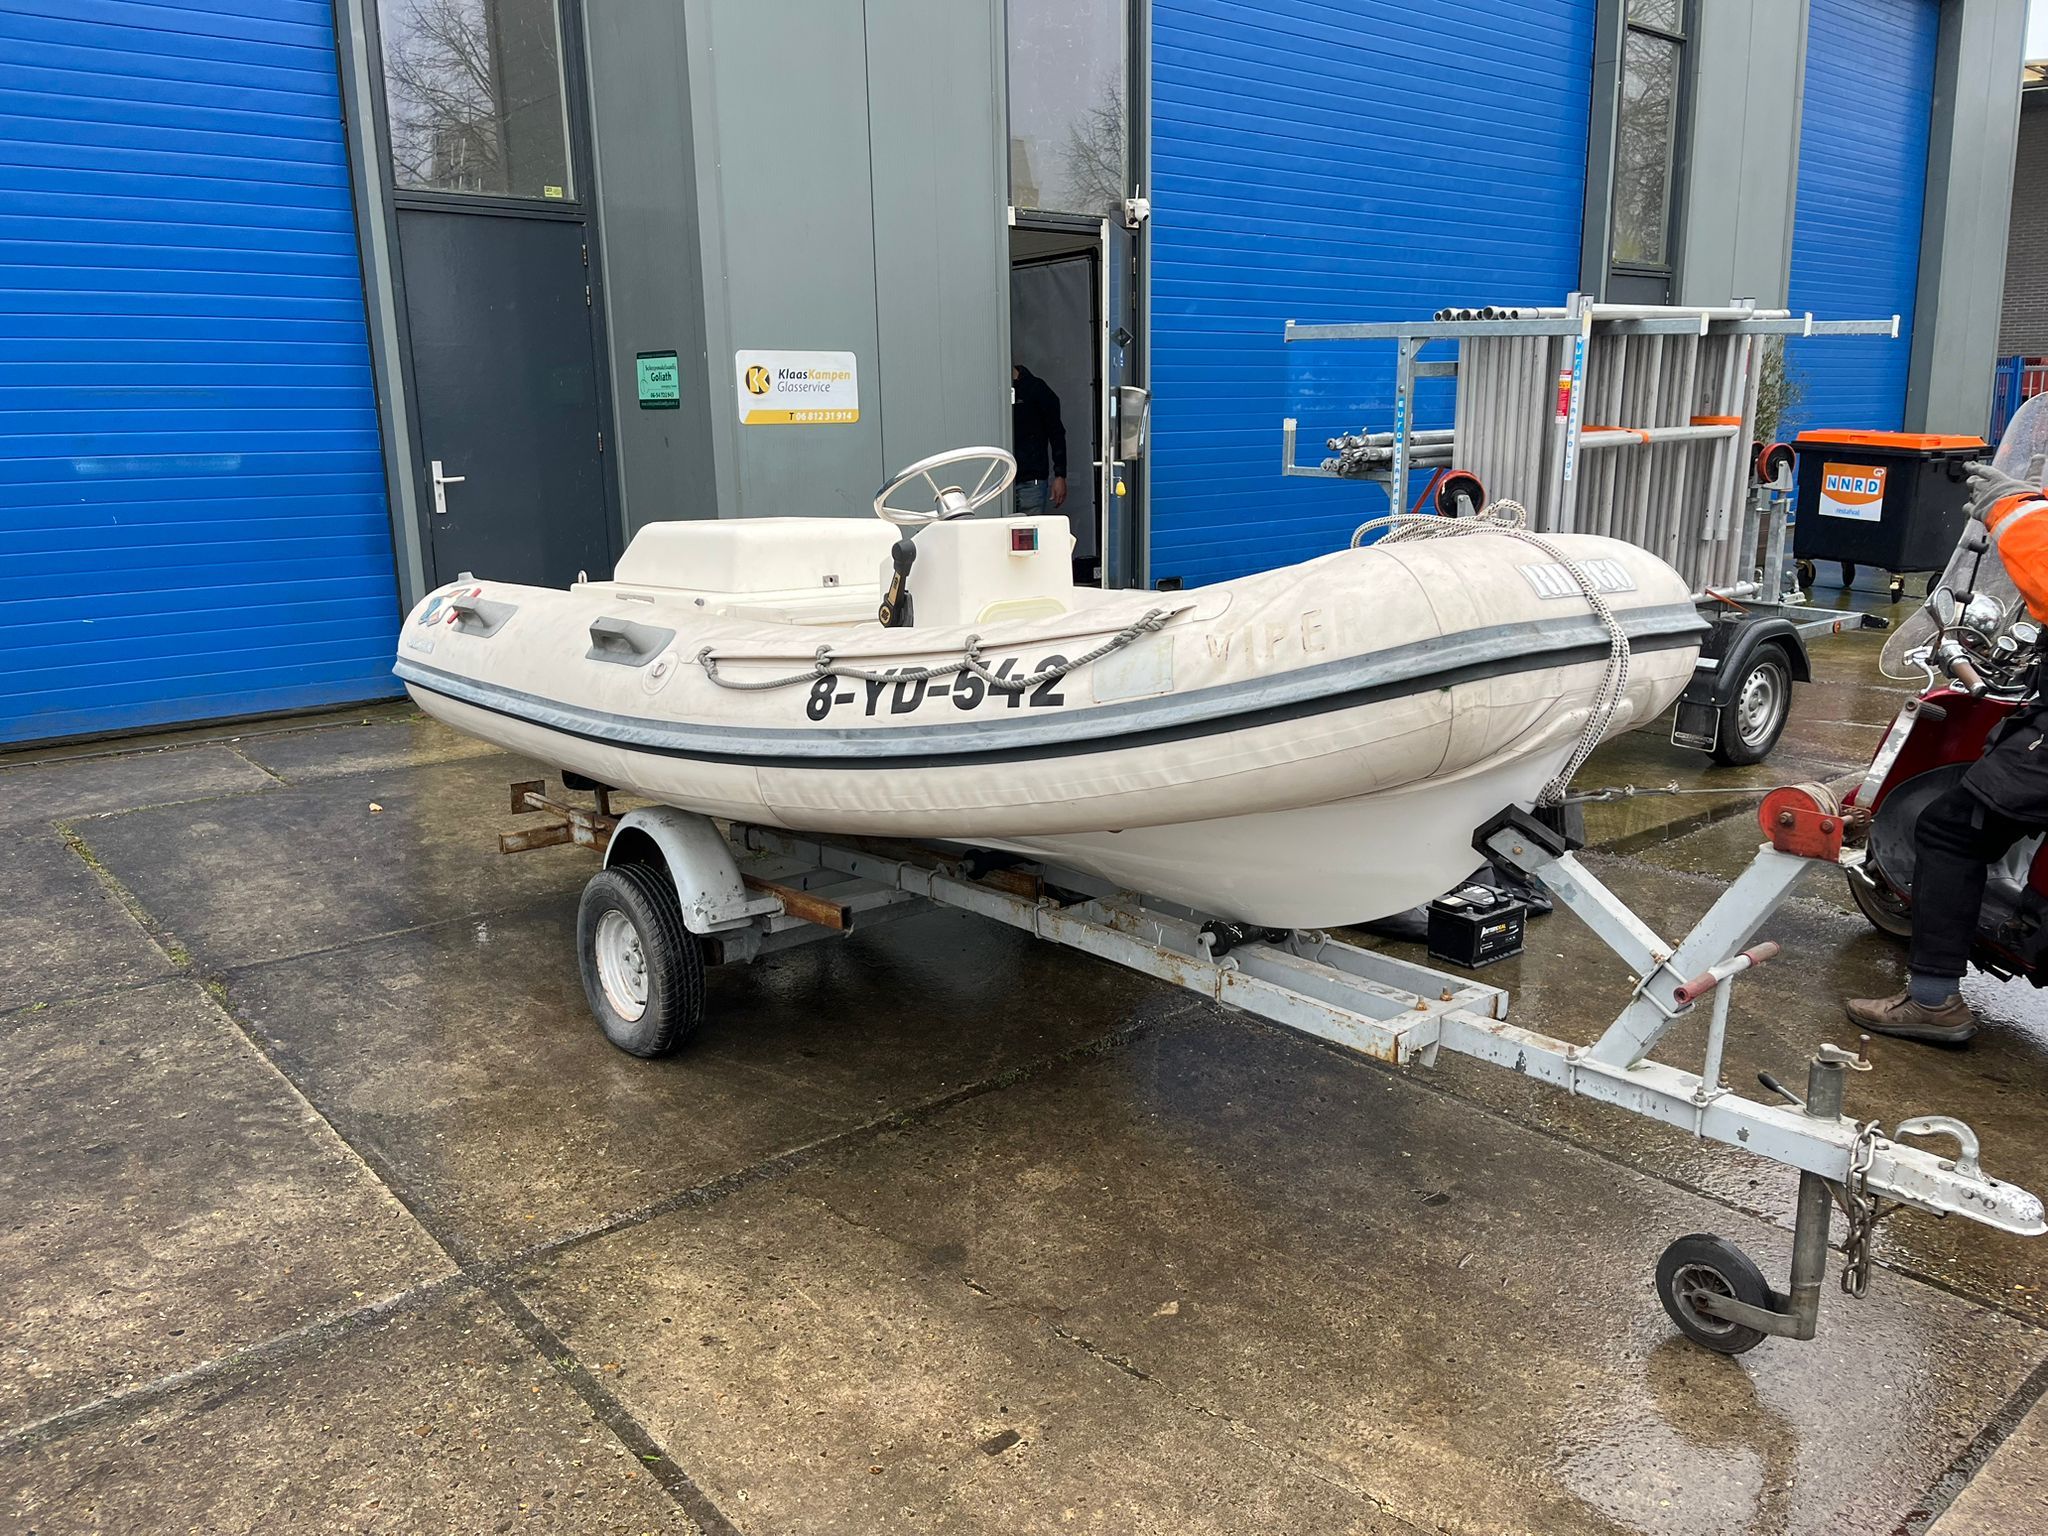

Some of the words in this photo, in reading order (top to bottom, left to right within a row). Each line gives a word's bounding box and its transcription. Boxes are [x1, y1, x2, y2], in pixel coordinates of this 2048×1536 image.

[650, 371, 672, 382] Goliath
[777, 381, 831, 393] Glasservice
[789, 412, 795, 421] T
[1827, 476, 1878, 493] NNRD
[806, 654, 1069, 722] 8-YD-542
